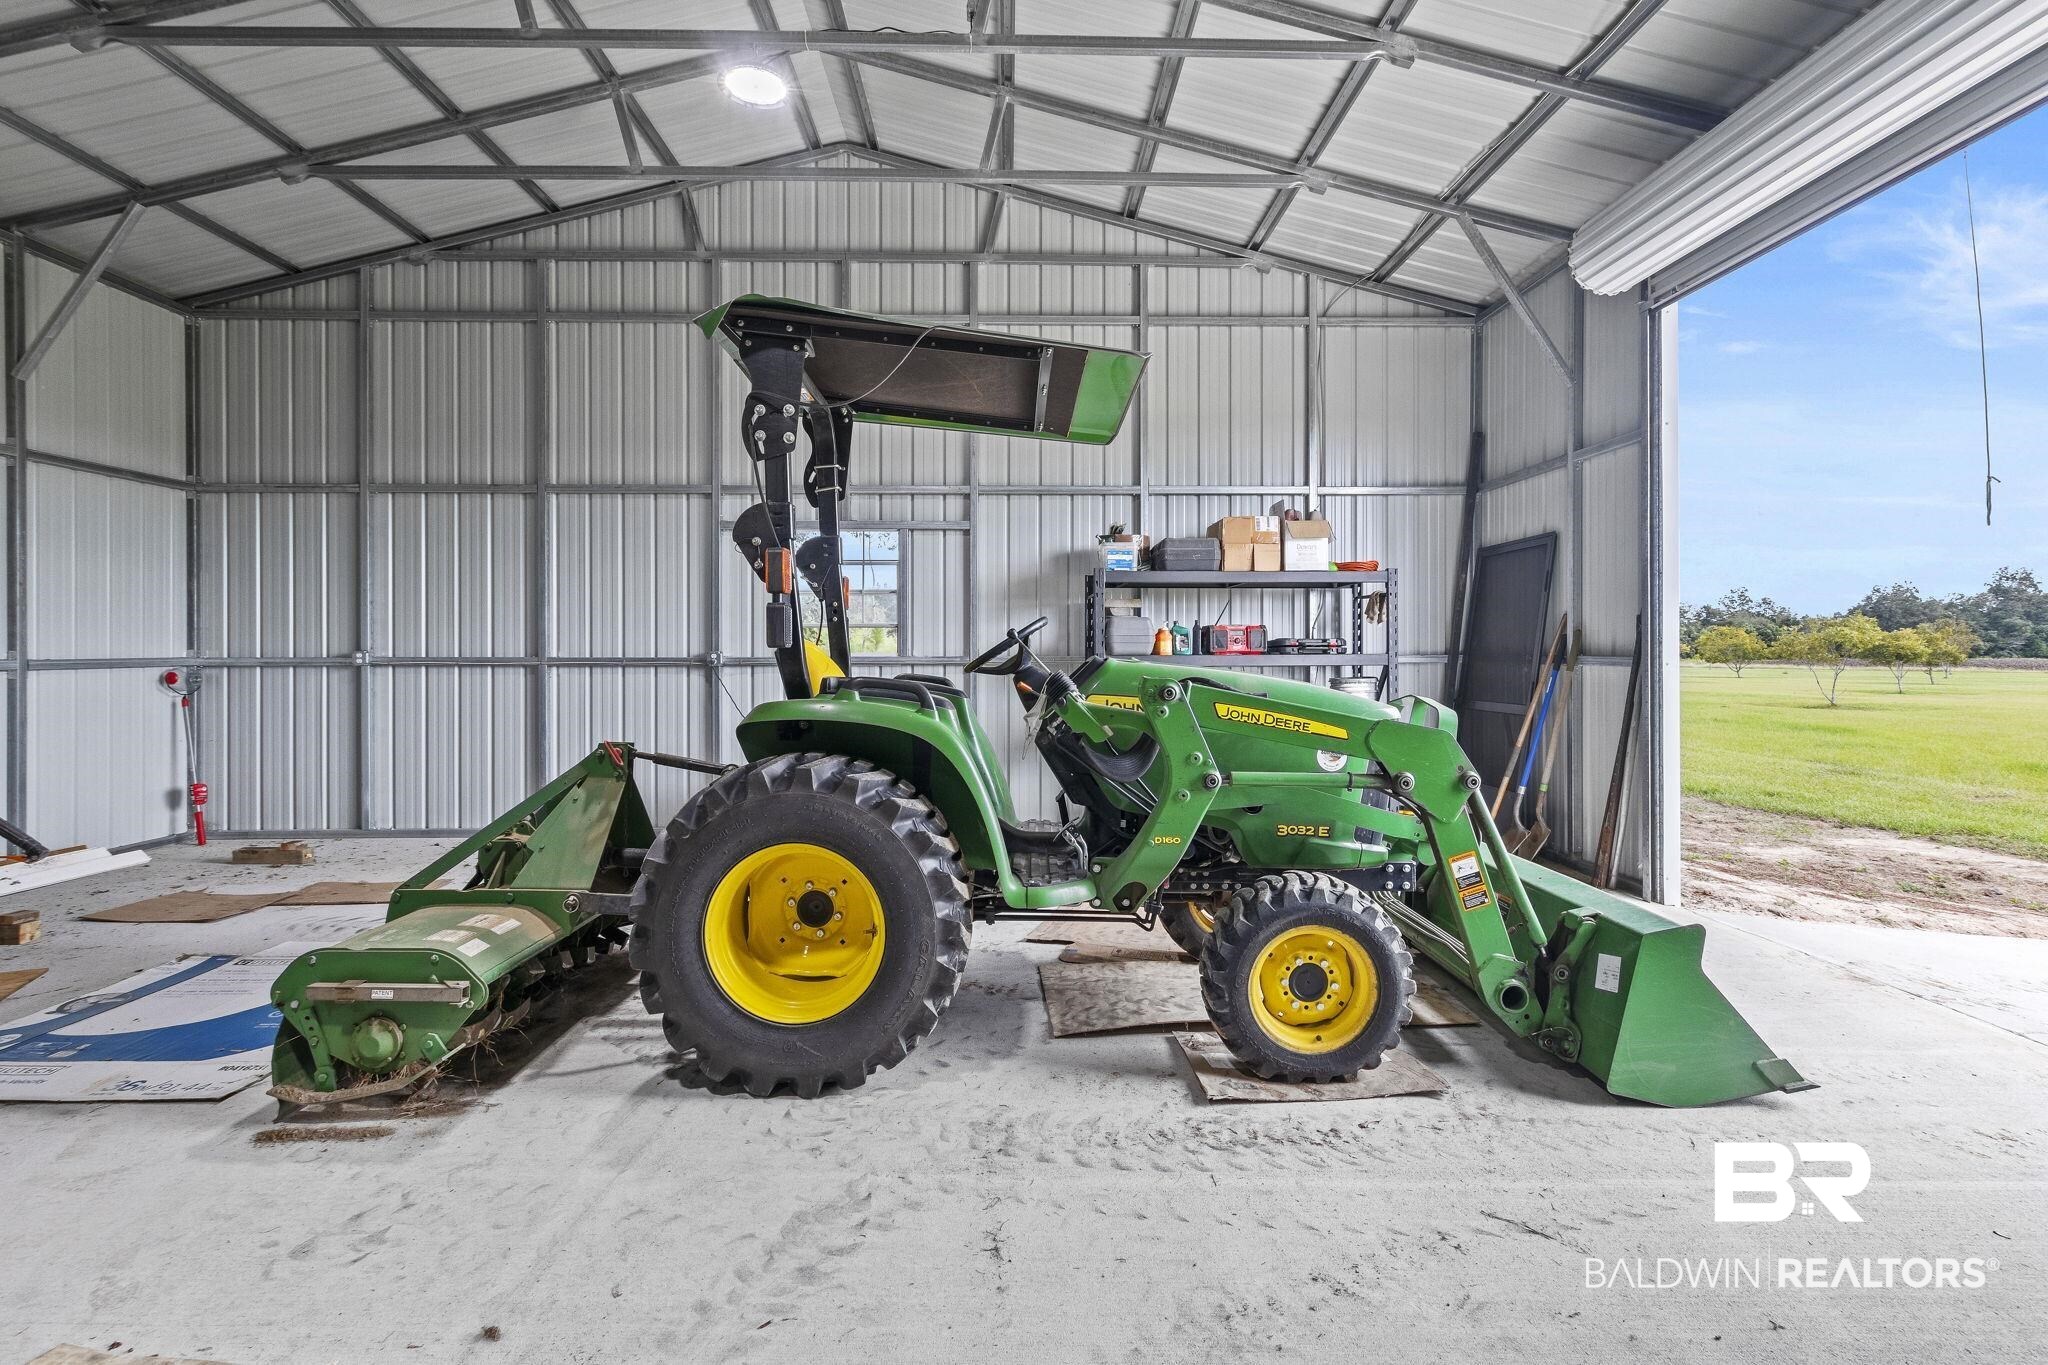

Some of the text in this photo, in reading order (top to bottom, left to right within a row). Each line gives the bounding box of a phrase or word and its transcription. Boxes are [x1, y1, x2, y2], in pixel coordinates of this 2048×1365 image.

[1222, 706, 1311, 732] JOHN DEERE
[1277, 824, 1331, 837] 3032 E
